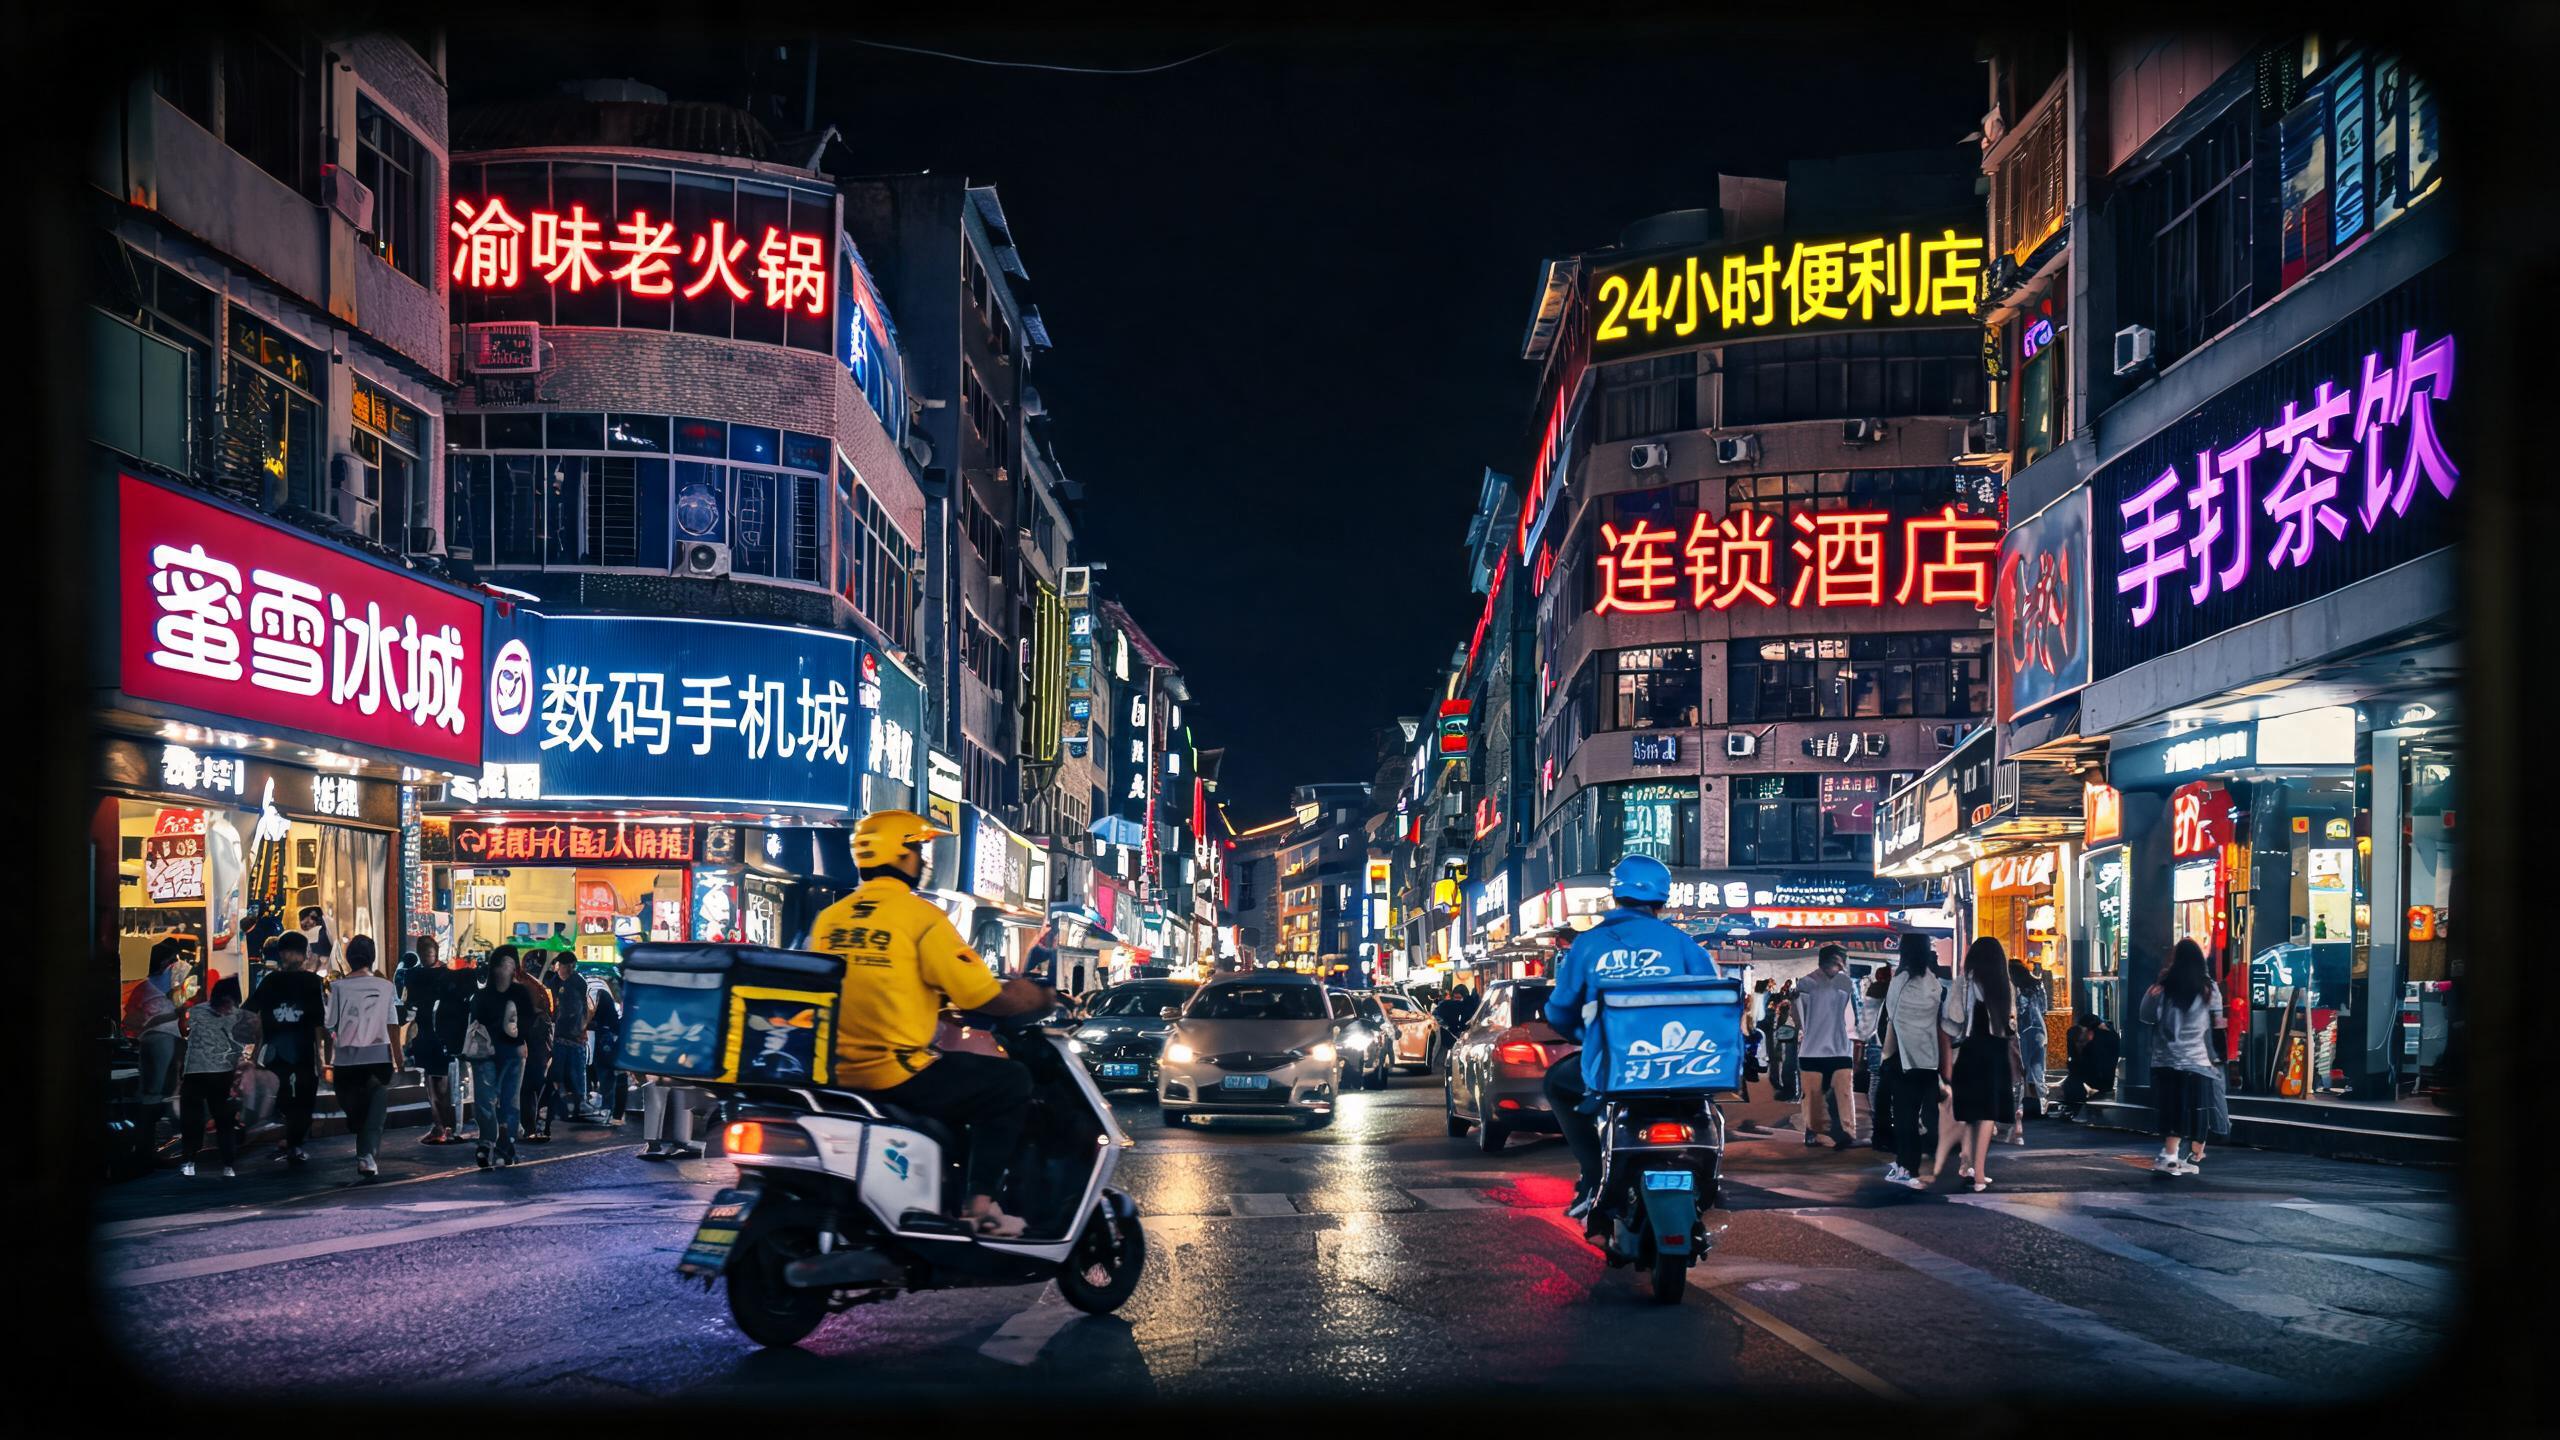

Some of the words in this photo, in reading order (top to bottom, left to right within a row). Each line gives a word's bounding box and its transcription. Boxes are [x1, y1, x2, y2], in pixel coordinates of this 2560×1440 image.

[451, 198, 826, 315] 渝味老火锅
[1596, 229, 1983, 342] 24小时便利店
[2117, 328, 2461, 628] 手打茶饮
[1594, 505, 2001, 616] 连锁酒店
[151, 543, 466, 735] 蜜雪冰城
[539, 664, 850, 766] 数码手机城
